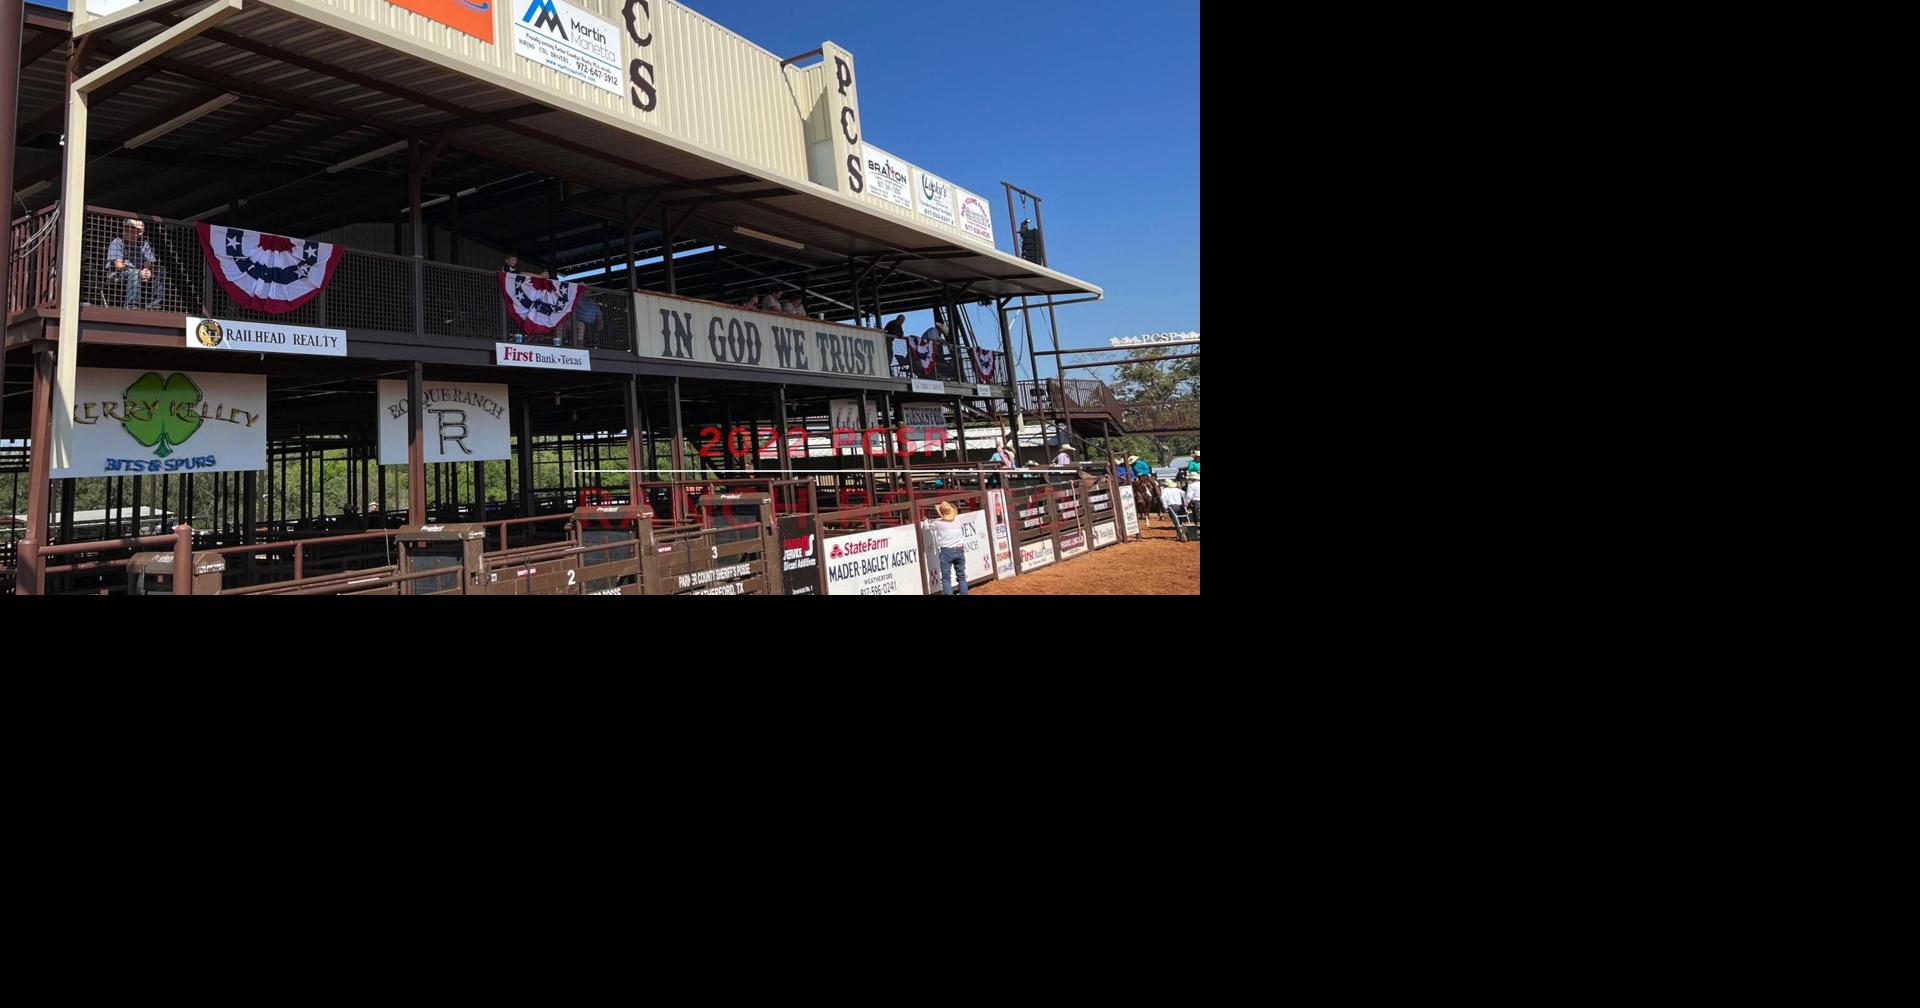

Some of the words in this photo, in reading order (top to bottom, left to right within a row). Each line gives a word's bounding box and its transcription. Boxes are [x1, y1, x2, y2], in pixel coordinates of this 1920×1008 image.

[570, 17, 607, 45] Martin
[570, 31, 616, 63] Marietta
[575, 61, 619, 86] 972-647-3912
[225, 328, 287, 345] RAILHEAD
[293, 334, 339, 348] REALTY
[660, 308, 695, 360] IN
[708, 316, 762, 366] GOD
[771, 325, 809, 370] WE
[816, 331, 876, 376] TRUST
[503, 346, 534, 363] First
[535, 353, 557, 365] Bank
[561, 357, 582, 366] Texas
[169, 400, 260, 428] KELLEY
[387, 388, 452, 420] BOQUE
[452, 388, 506, 420] RANCH
[104, 458, 145, 471] BITS
[164, 455, 217, 471] SPURS
[711, 546, 719, 560] 3
[844, 537, 889, 557] StateFarm
[891, 548, 918, 569] AGENCY
[567, 569, 576, 586] 2
[697, 569, 716, 585] COUNTY
[736, 582, 745, 594] TX
